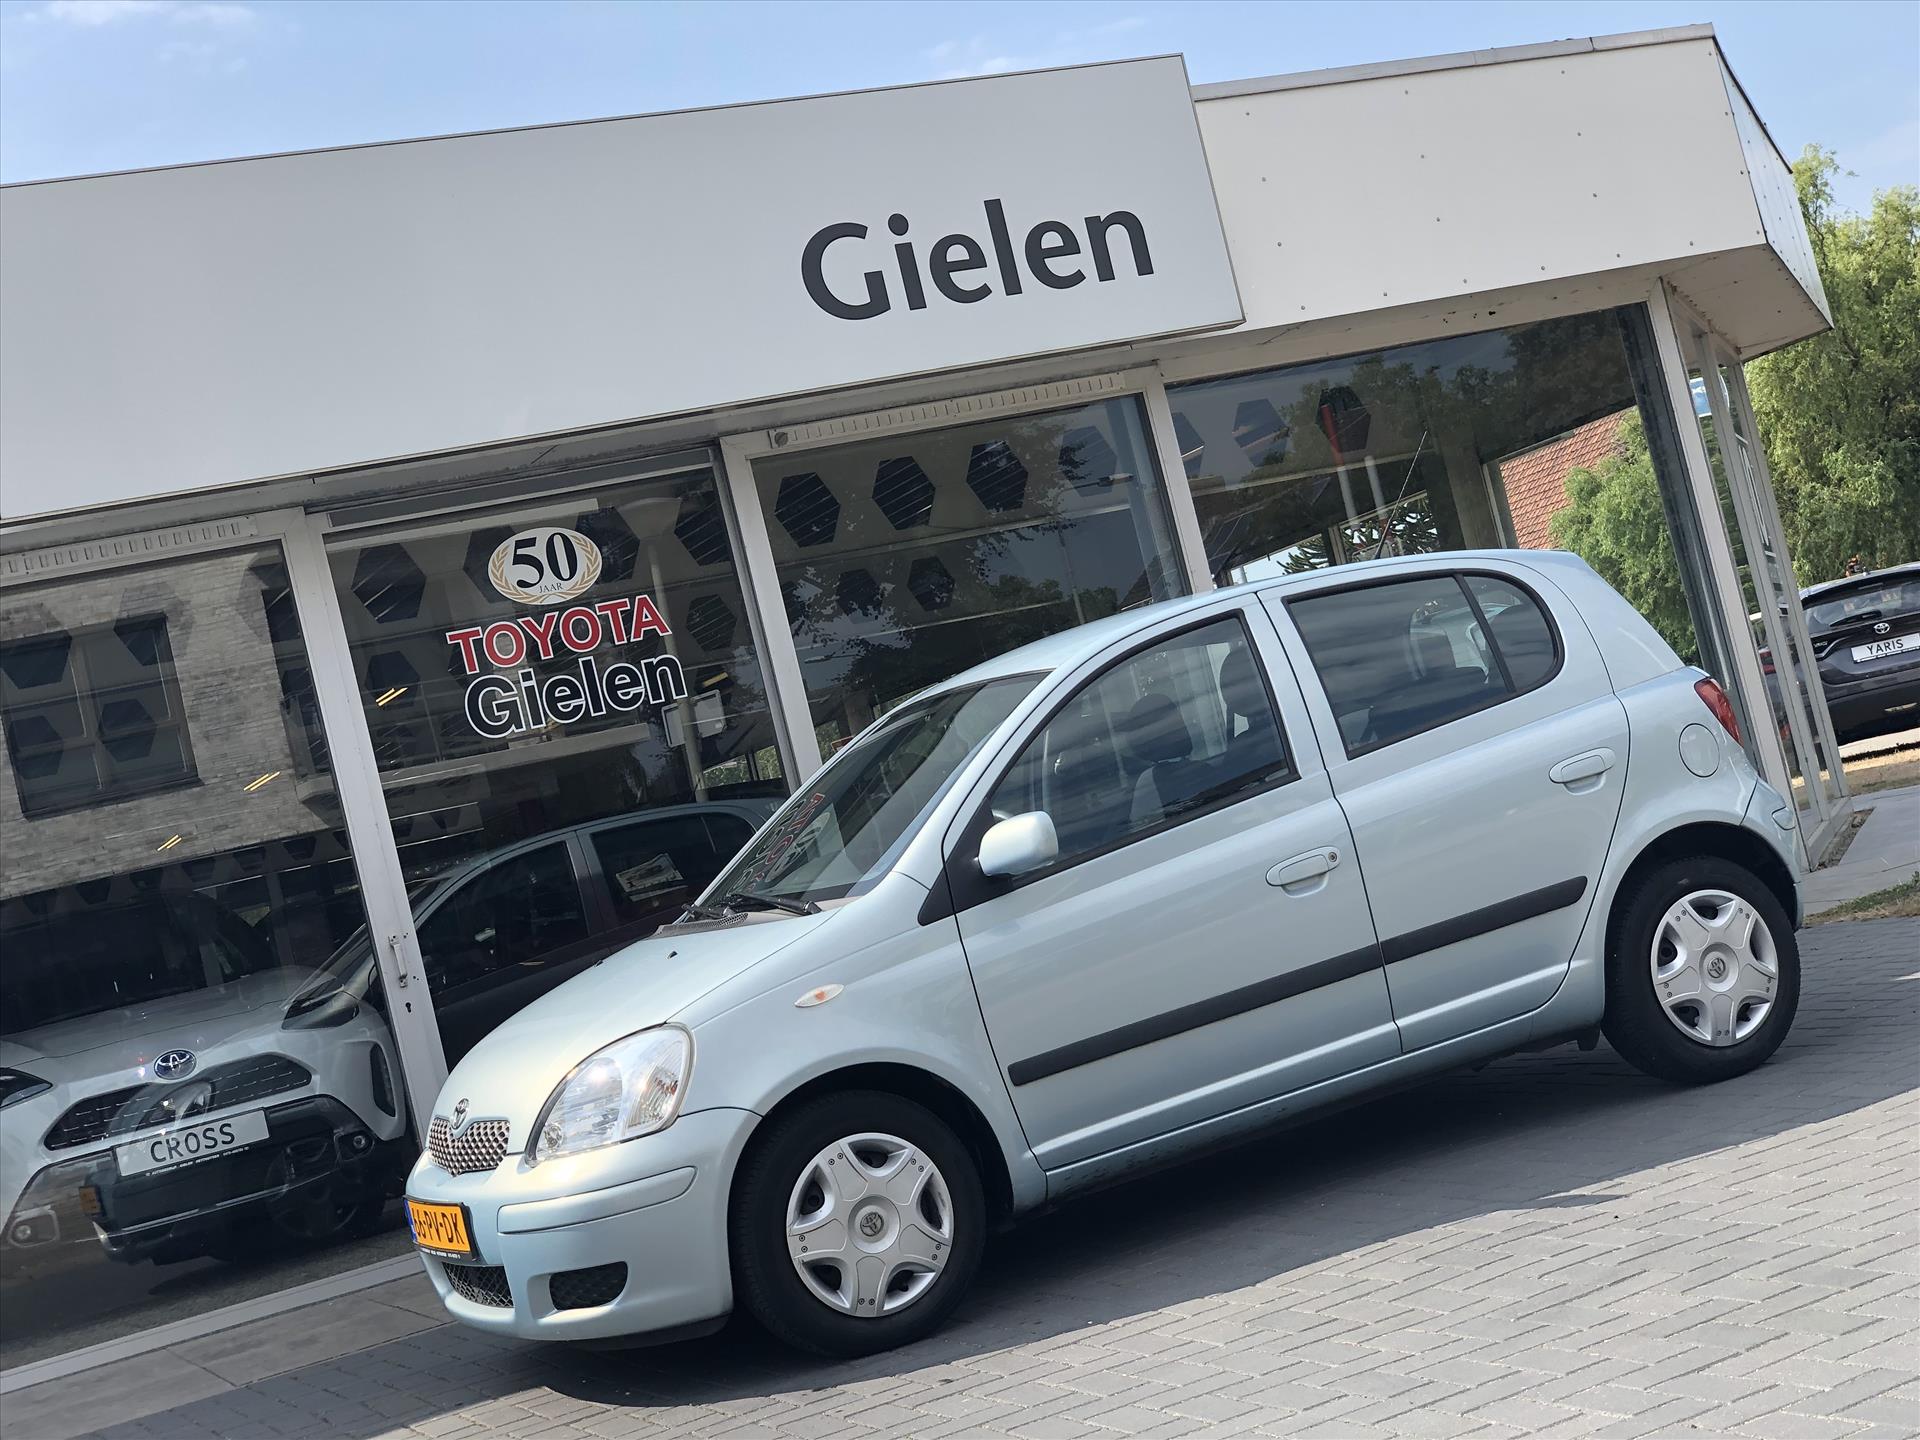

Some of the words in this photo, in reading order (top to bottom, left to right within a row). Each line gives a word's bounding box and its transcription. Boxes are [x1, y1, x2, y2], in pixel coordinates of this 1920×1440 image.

[801, 198, 1154, 320] Gielen
[511, 532, 578, 588] 50
[539, 582, 563, 594] JAAR
[446, 594, 672, 674] TOYOTA
[1867, 638, 1904, 655] YARIS
[465, 654, 688, 738] Gielen
[150, 1123, 235, 1163] CROSS
[411, 1207, 464, 1245] 66-PV-DK
